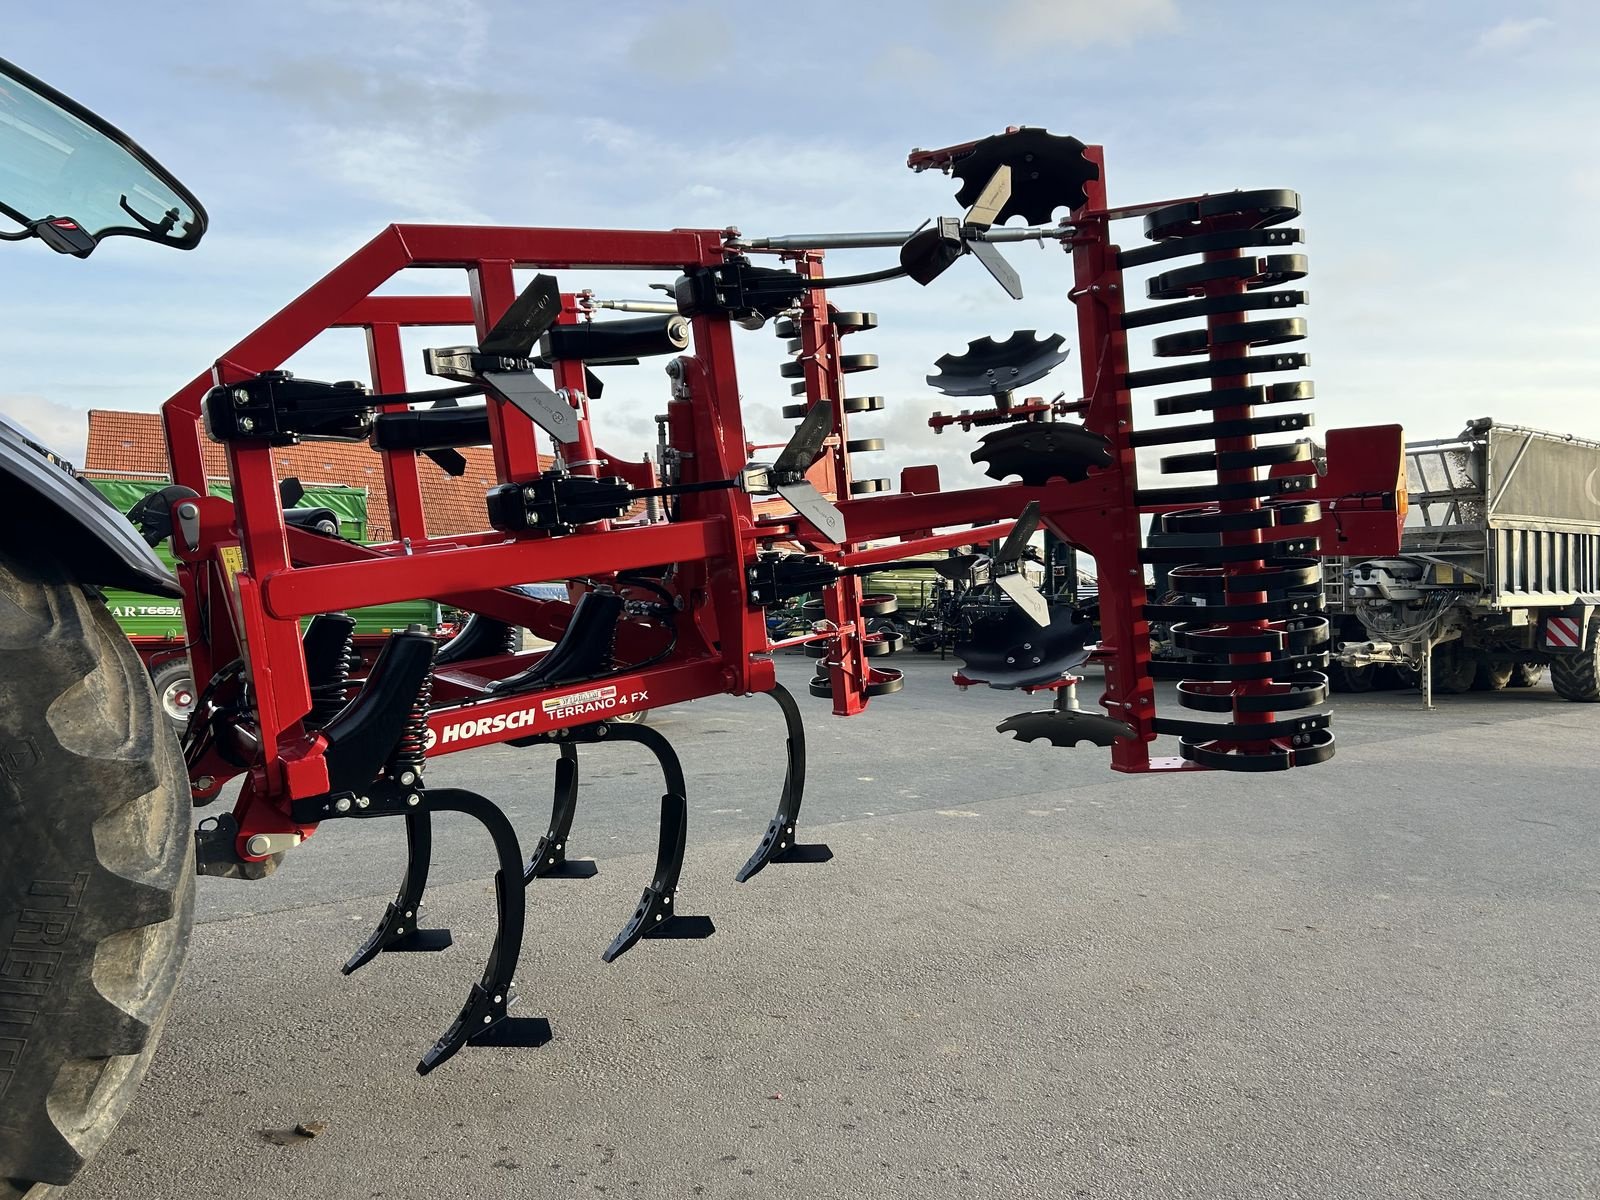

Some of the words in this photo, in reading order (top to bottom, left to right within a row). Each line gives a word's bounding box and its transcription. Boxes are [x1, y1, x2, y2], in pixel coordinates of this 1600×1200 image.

[105, 606, 137, 617] AR
[546, 698, 617, 720] TERRANO
[619, 694, 629, 705] 4
[631, 690, 649, 704] FX
[442, 708, 536, 744] HORSCH
